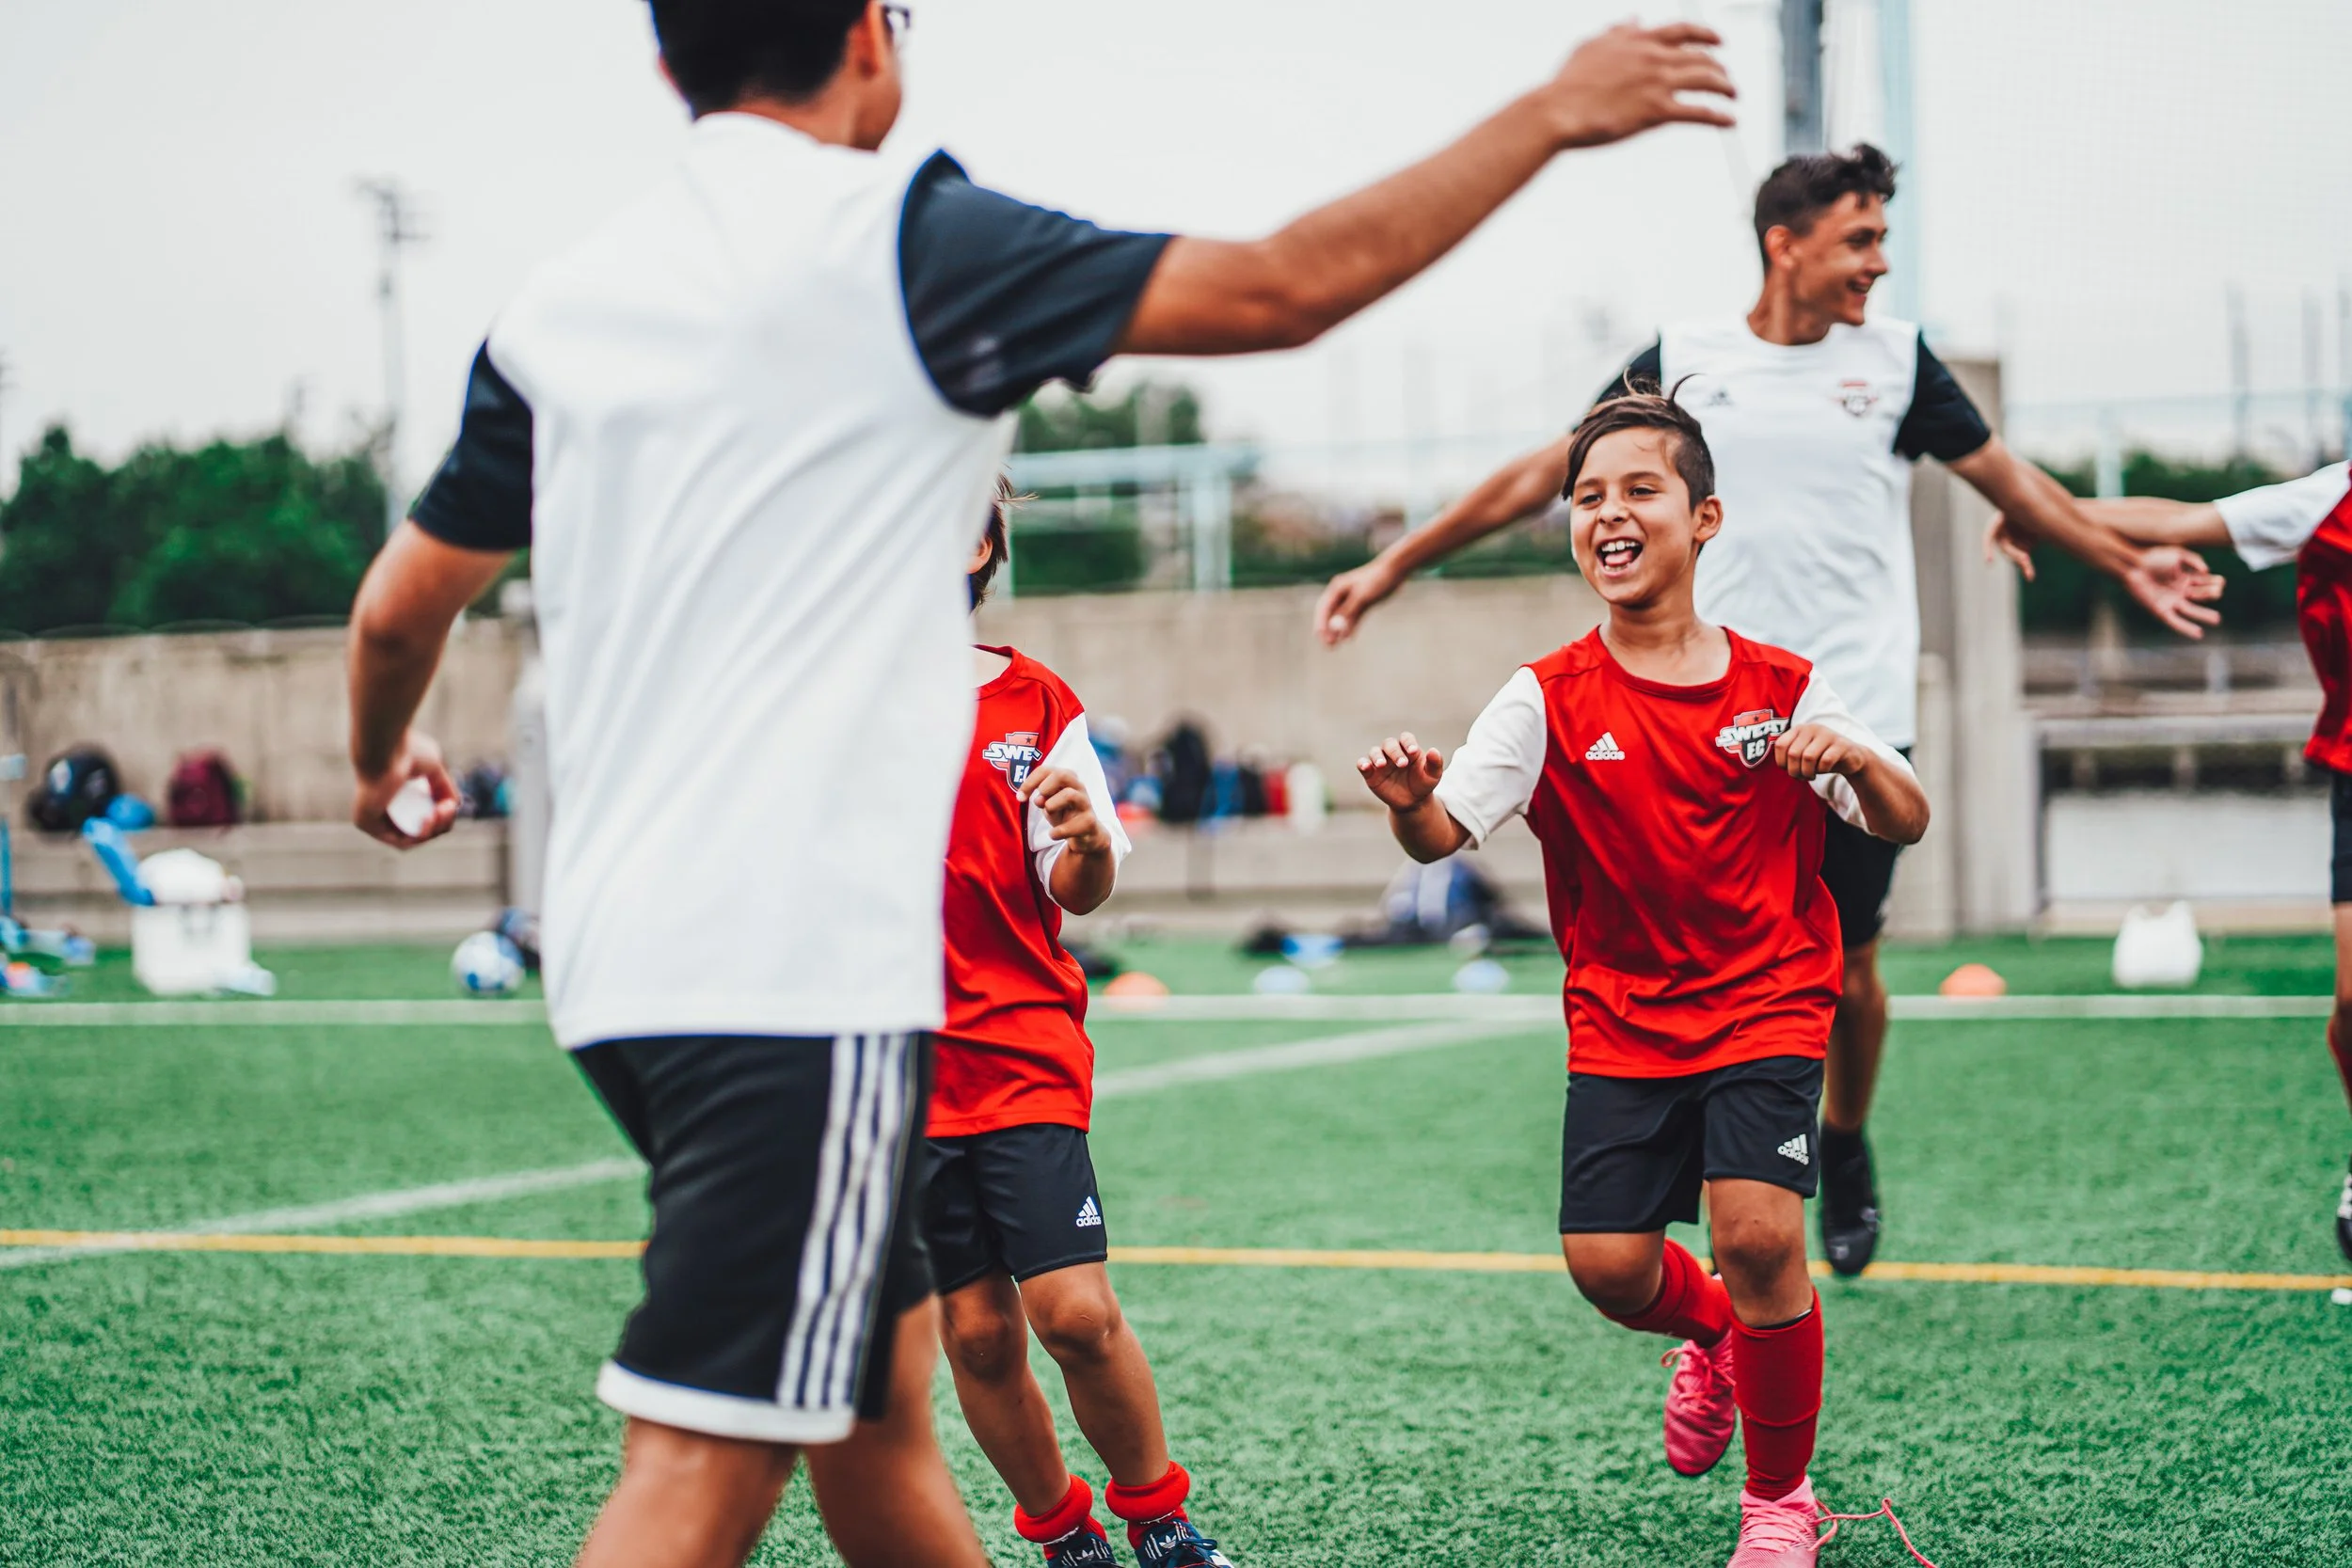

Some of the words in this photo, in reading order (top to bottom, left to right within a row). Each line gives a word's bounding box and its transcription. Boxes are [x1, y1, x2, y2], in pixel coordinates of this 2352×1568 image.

[1584, 749, 1626, 760] adidas
[1776, 1145, 1809, 1165] adidas
[1075, 1214, 1102, 1227] adidas
